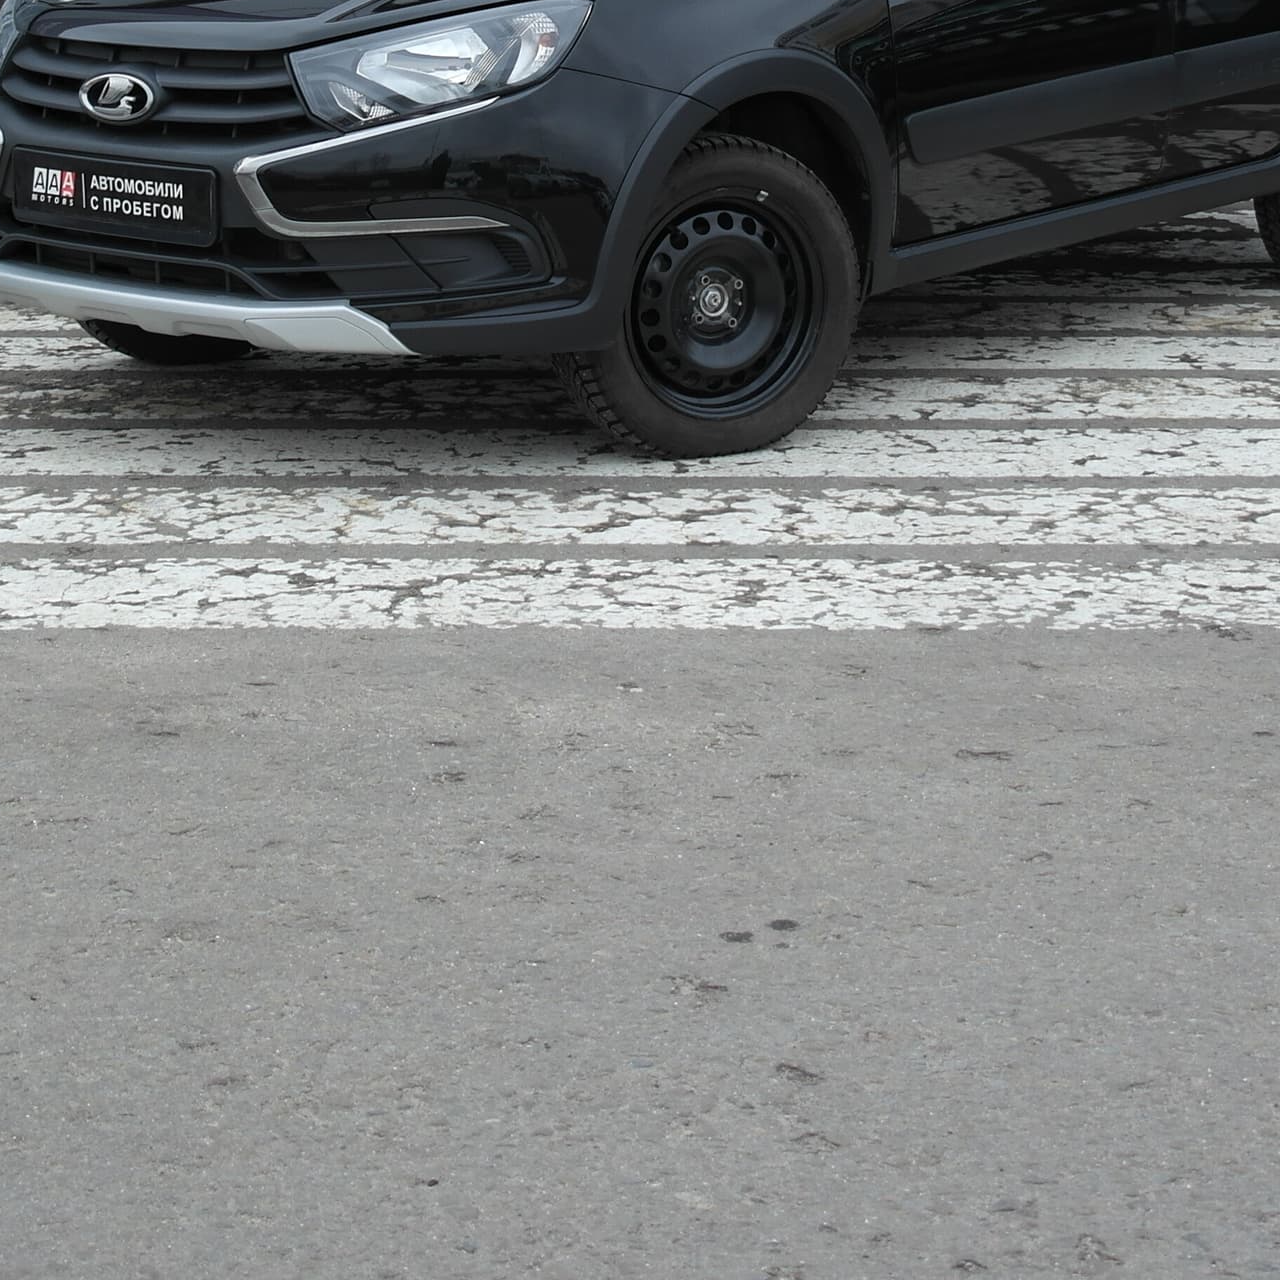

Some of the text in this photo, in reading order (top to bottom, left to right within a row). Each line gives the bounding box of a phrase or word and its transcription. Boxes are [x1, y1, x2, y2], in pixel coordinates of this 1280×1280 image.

[90, 174, 183, 200] АВТОМОБИЛИ
[32, 194, 74, 207] MOTORS
[103, 198, 183, 221] ПРОБЕГОМ
